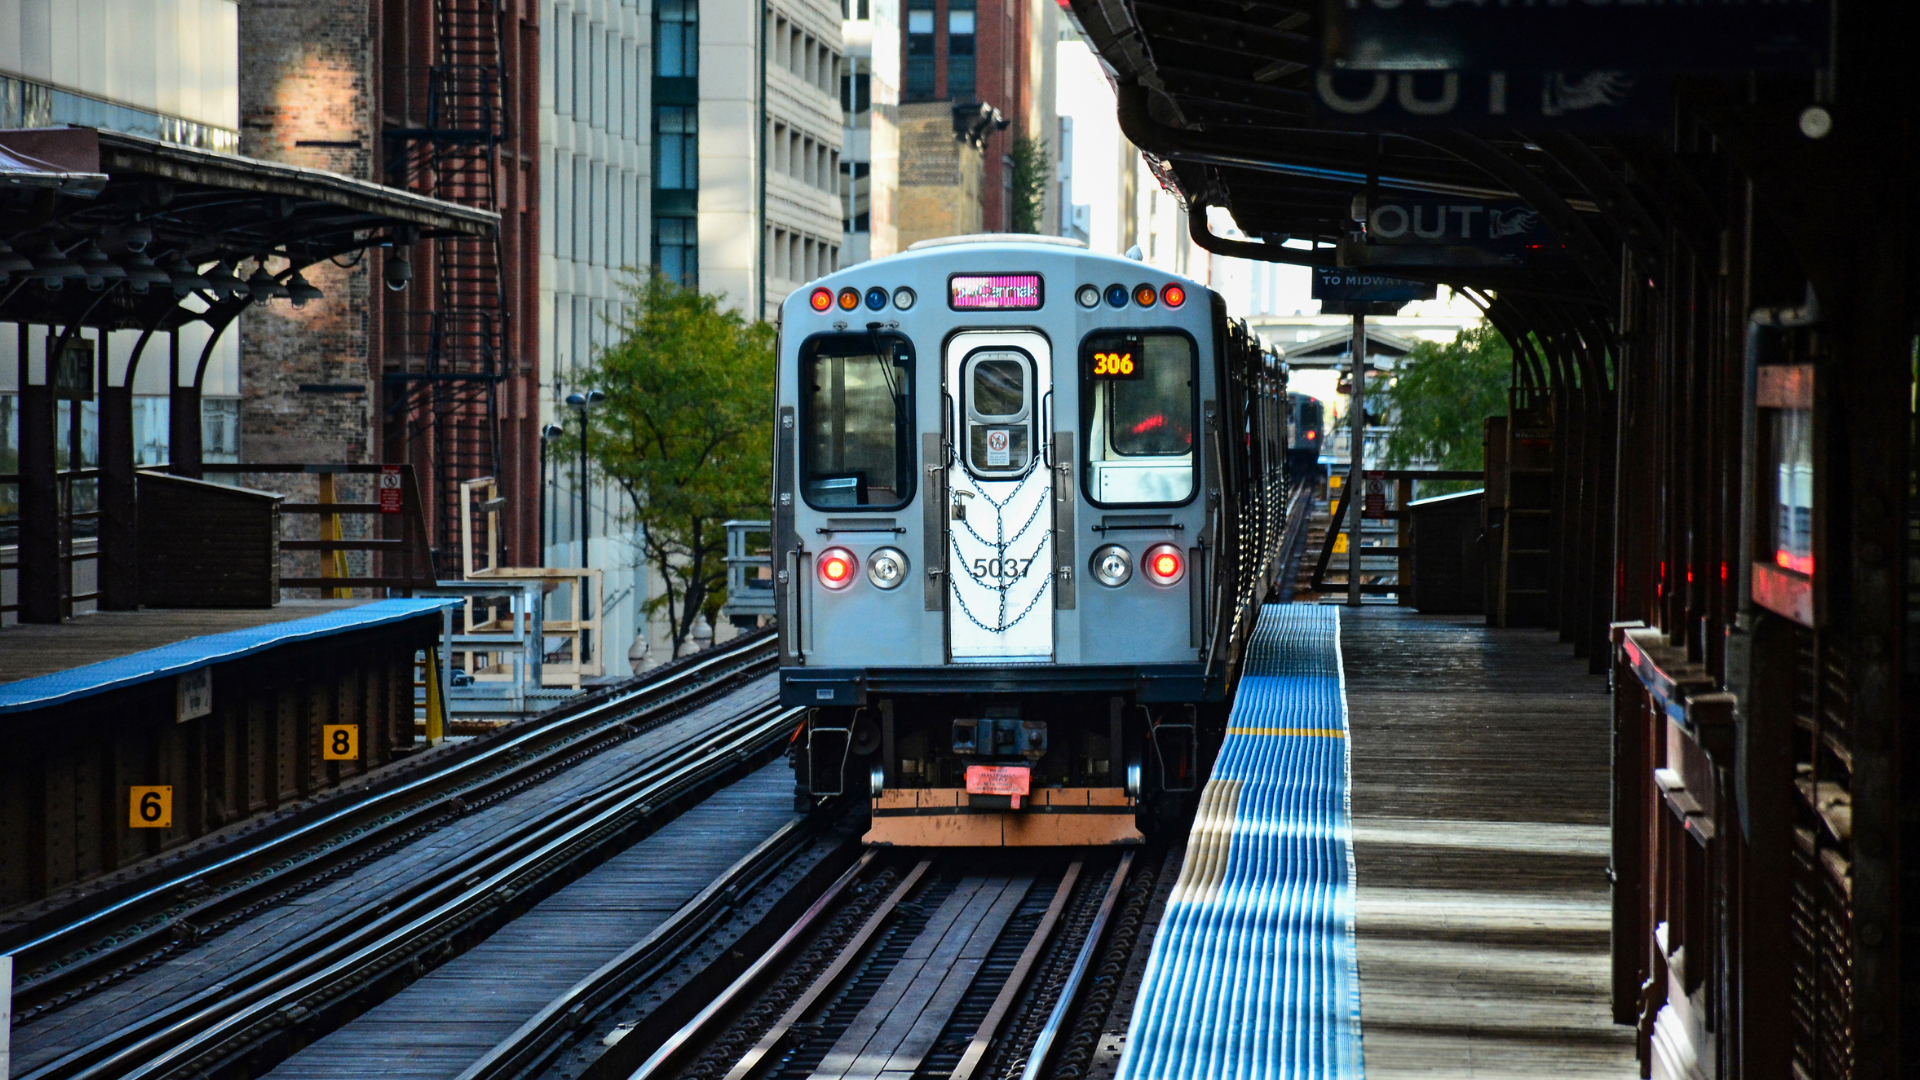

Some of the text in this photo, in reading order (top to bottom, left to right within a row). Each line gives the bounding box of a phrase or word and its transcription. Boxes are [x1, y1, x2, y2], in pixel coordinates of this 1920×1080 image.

[1371, 204, 1483, 239] OUT
[1322, 276, 1341, 285] TO
[1093, 352, 1134, 375] 306
[973, 558, 1032, 578] 5037
[332, 729, 350, 755] 8
[140, 791, 162, 822] 6
